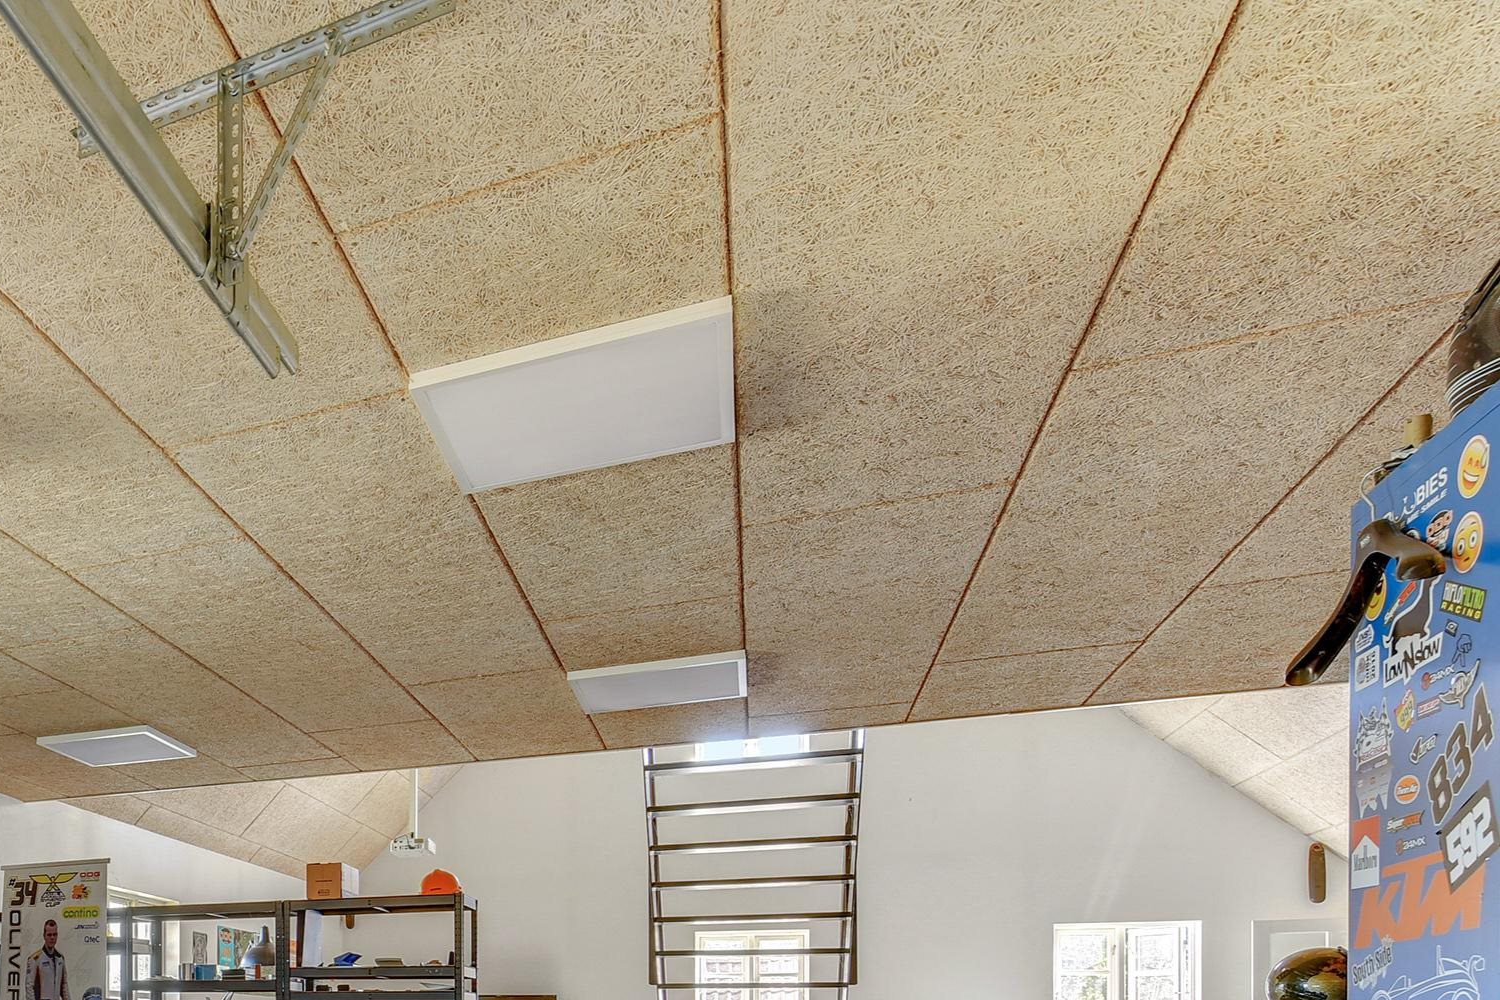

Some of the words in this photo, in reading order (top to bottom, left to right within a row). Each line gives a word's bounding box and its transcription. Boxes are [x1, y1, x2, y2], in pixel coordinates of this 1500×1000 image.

[1441, 602, 1481, 619] RACING
[1427, 682, 1495, 826] 834
[1402, 836, 1426, 850] 24MX
[1445, 796, 1495, 884] 592
[1353, 851, 1485, 949] KTM
[1352, 955, 1375, 985] South
[1374, 945, 1392, 971] Side
